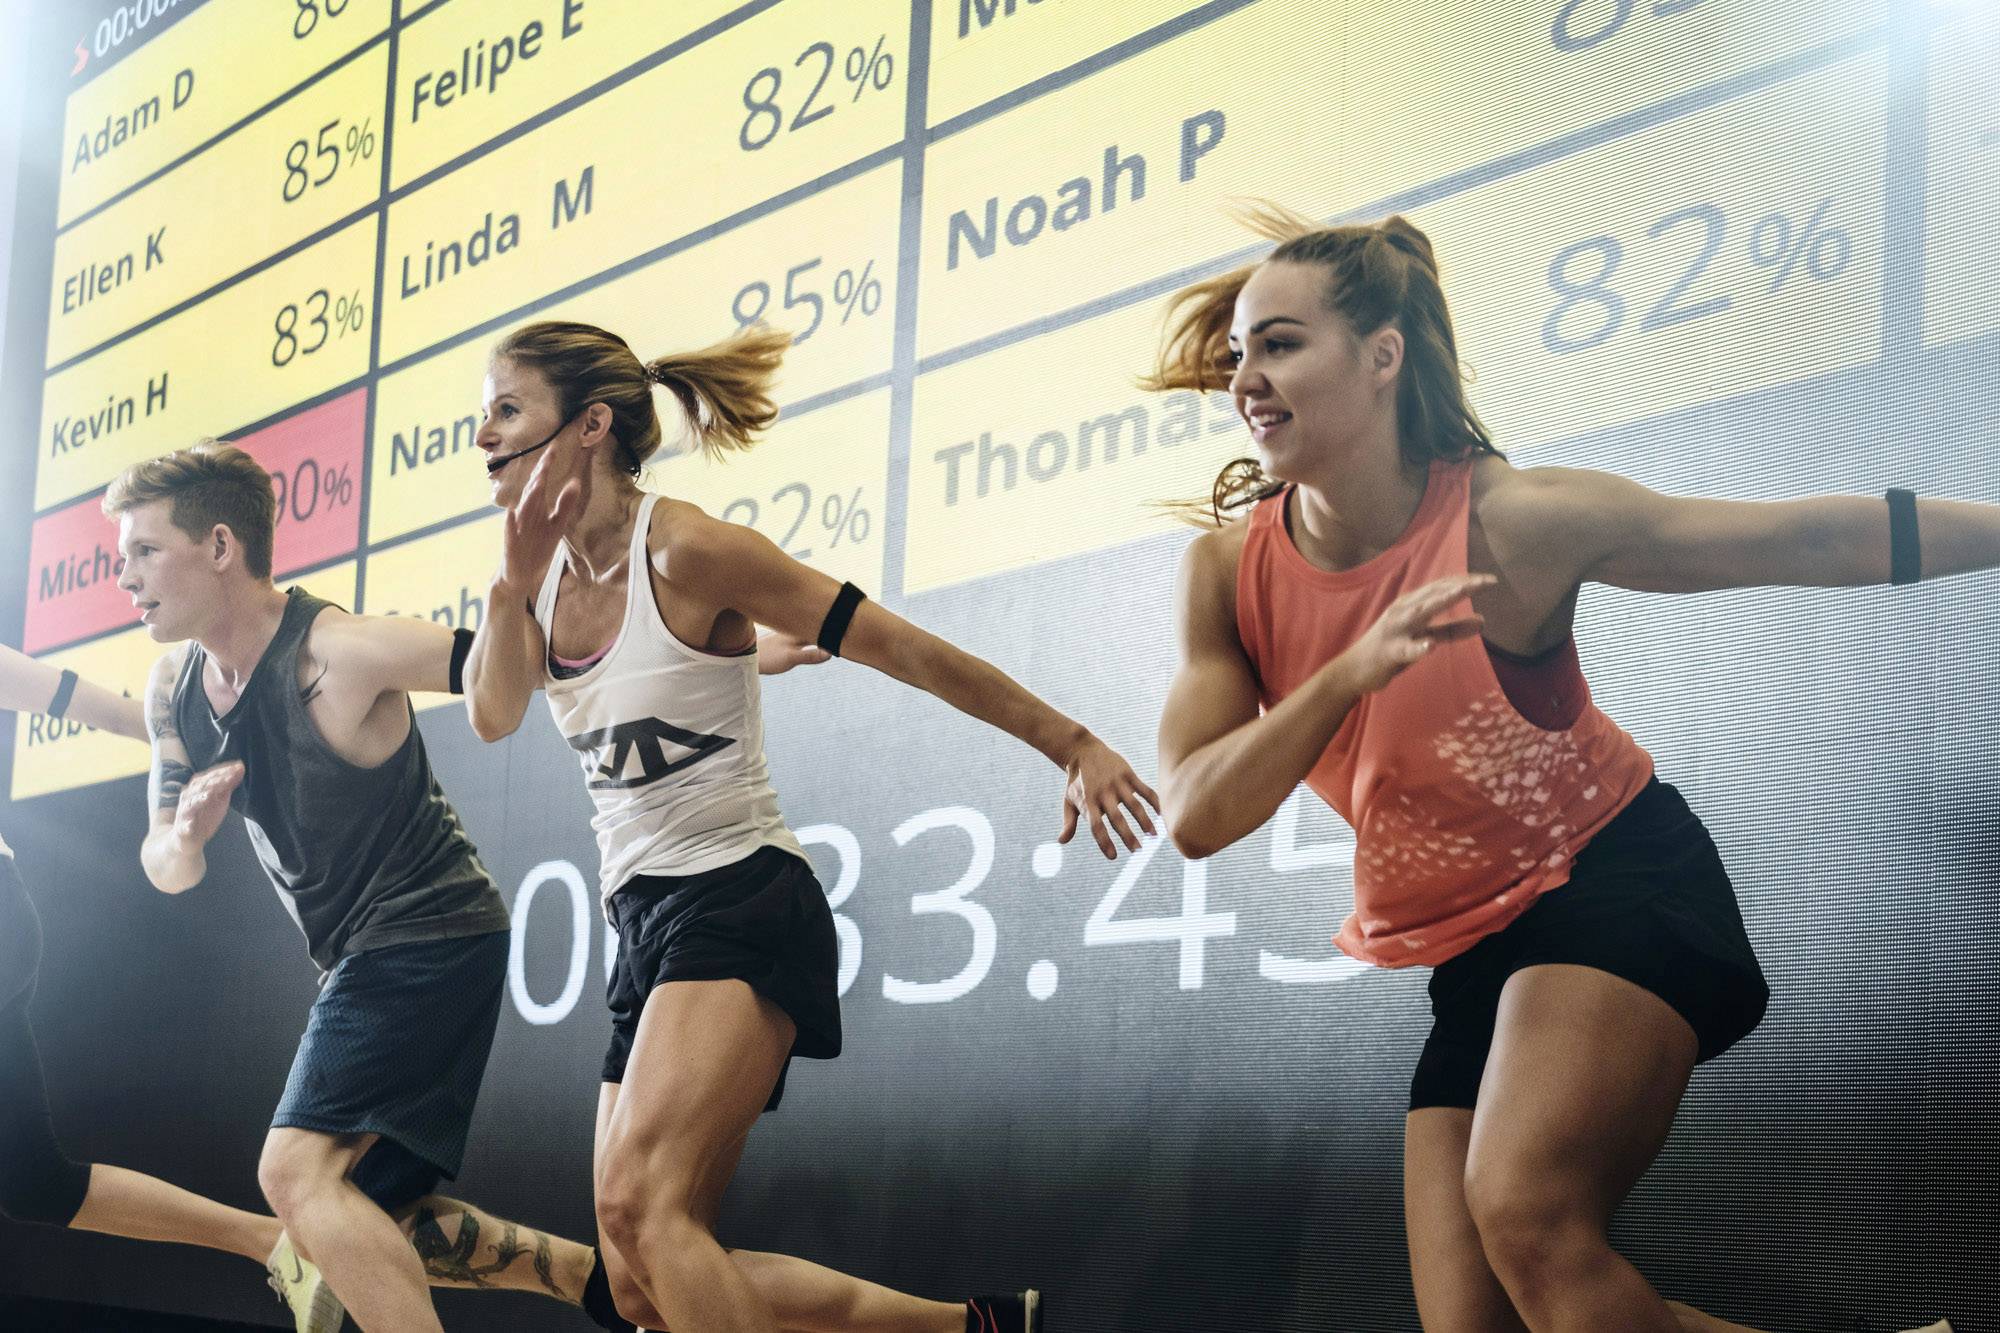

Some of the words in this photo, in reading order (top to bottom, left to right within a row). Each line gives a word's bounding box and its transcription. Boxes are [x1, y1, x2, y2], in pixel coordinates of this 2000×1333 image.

[71, 97, 161, 174] Adam
[173, 67, 195, 112] D
[410, 20, 544, 124] Felipe
[739, 34, 894, 151] 82%
[282, 117, 376, 203] 85%
[947, 145, 1147, 271] Noah
[1180, 109, 1226, 183] P
[62, 252, 135, 315] Ellen
[145, 227, 167, 267] K
[400, 212, 521, 300] Linda
[552, 165, 595, 230] M
[1541, 200, 1851, 355] 82%
[271, 288, 365, 369] 83%
[50, 395, 135, 458] Kevin
[146, 372, 169, 418] H
